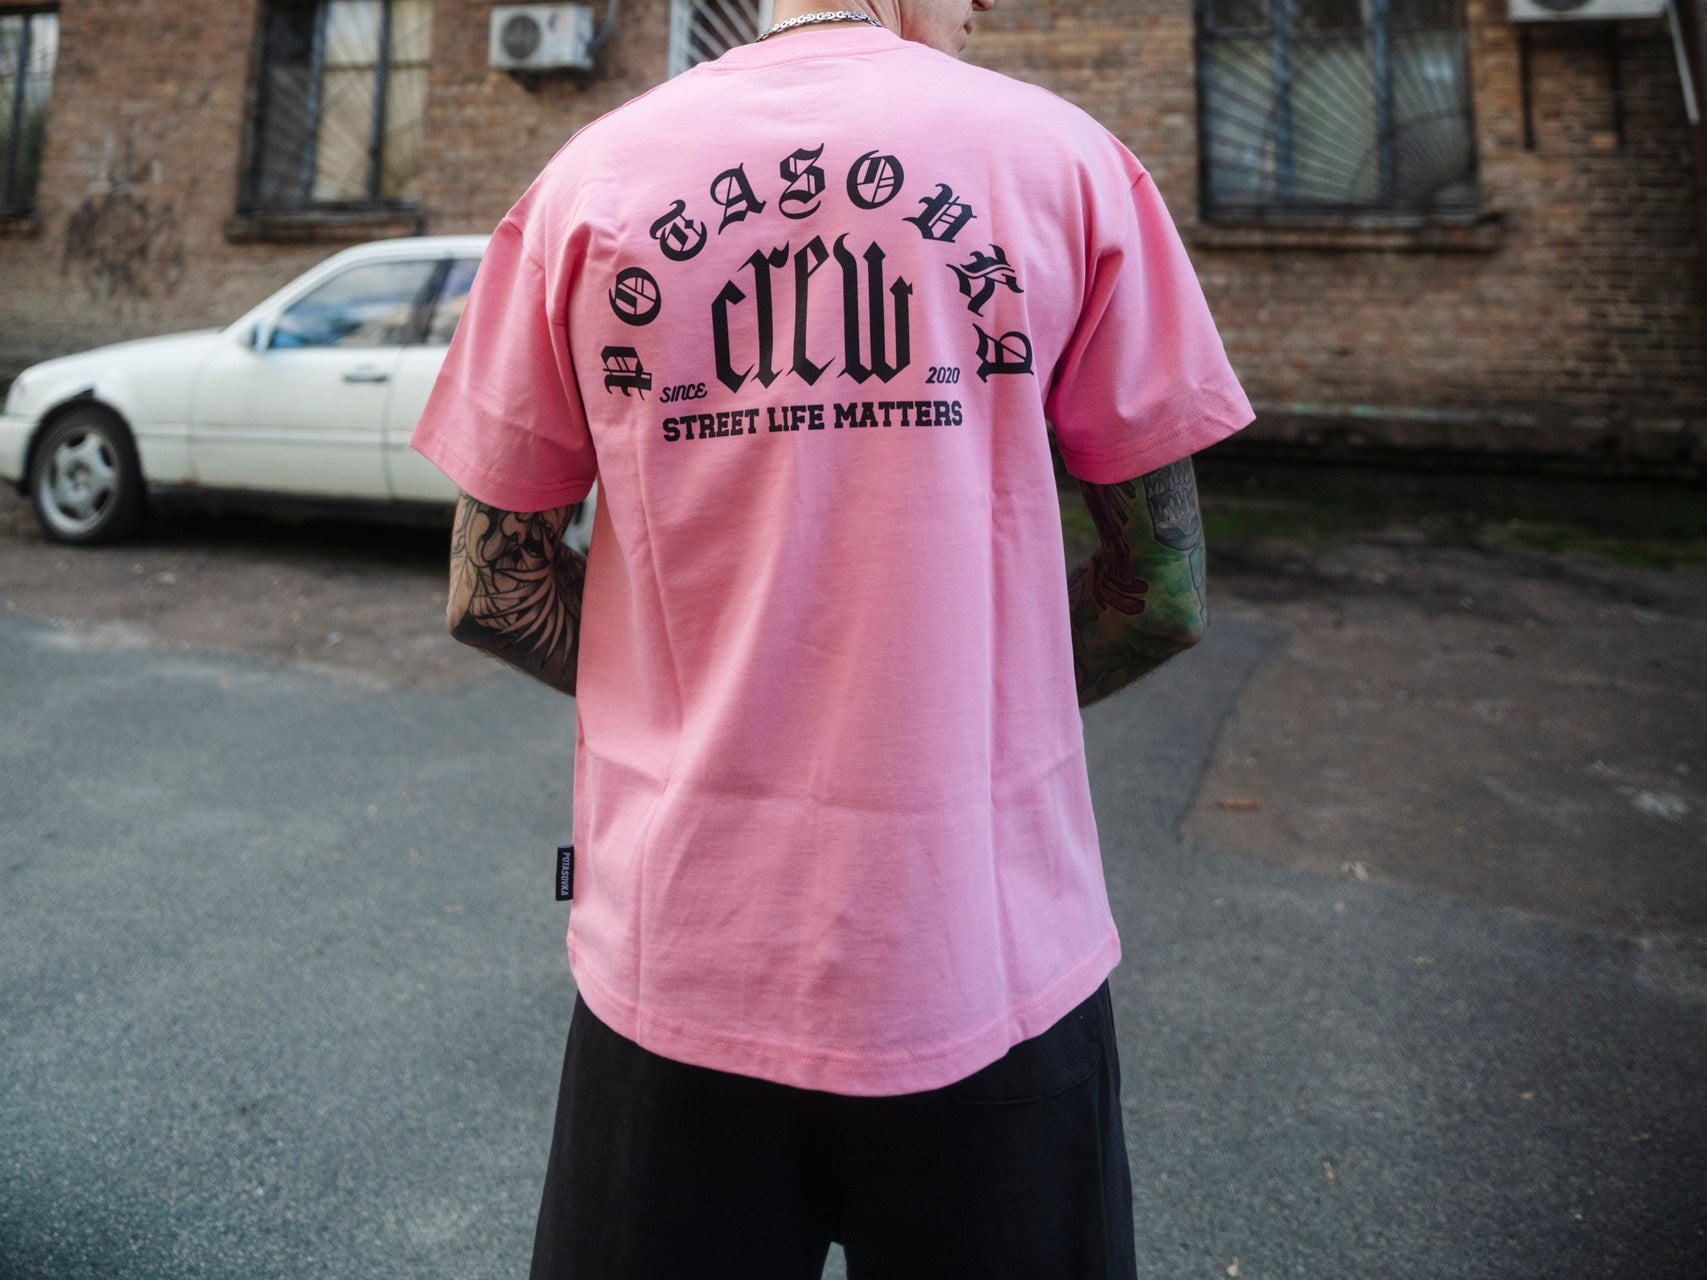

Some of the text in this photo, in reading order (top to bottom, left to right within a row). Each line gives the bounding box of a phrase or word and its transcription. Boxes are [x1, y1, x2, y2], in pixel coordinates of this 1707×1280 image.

[925, 366, 961, 384] 2020
[659, 382, 708, 404] SINCE
[662, 400, 964, 443] STREET LIFE MATTERS
[560, 852, 571, 896] POTASOVKA
